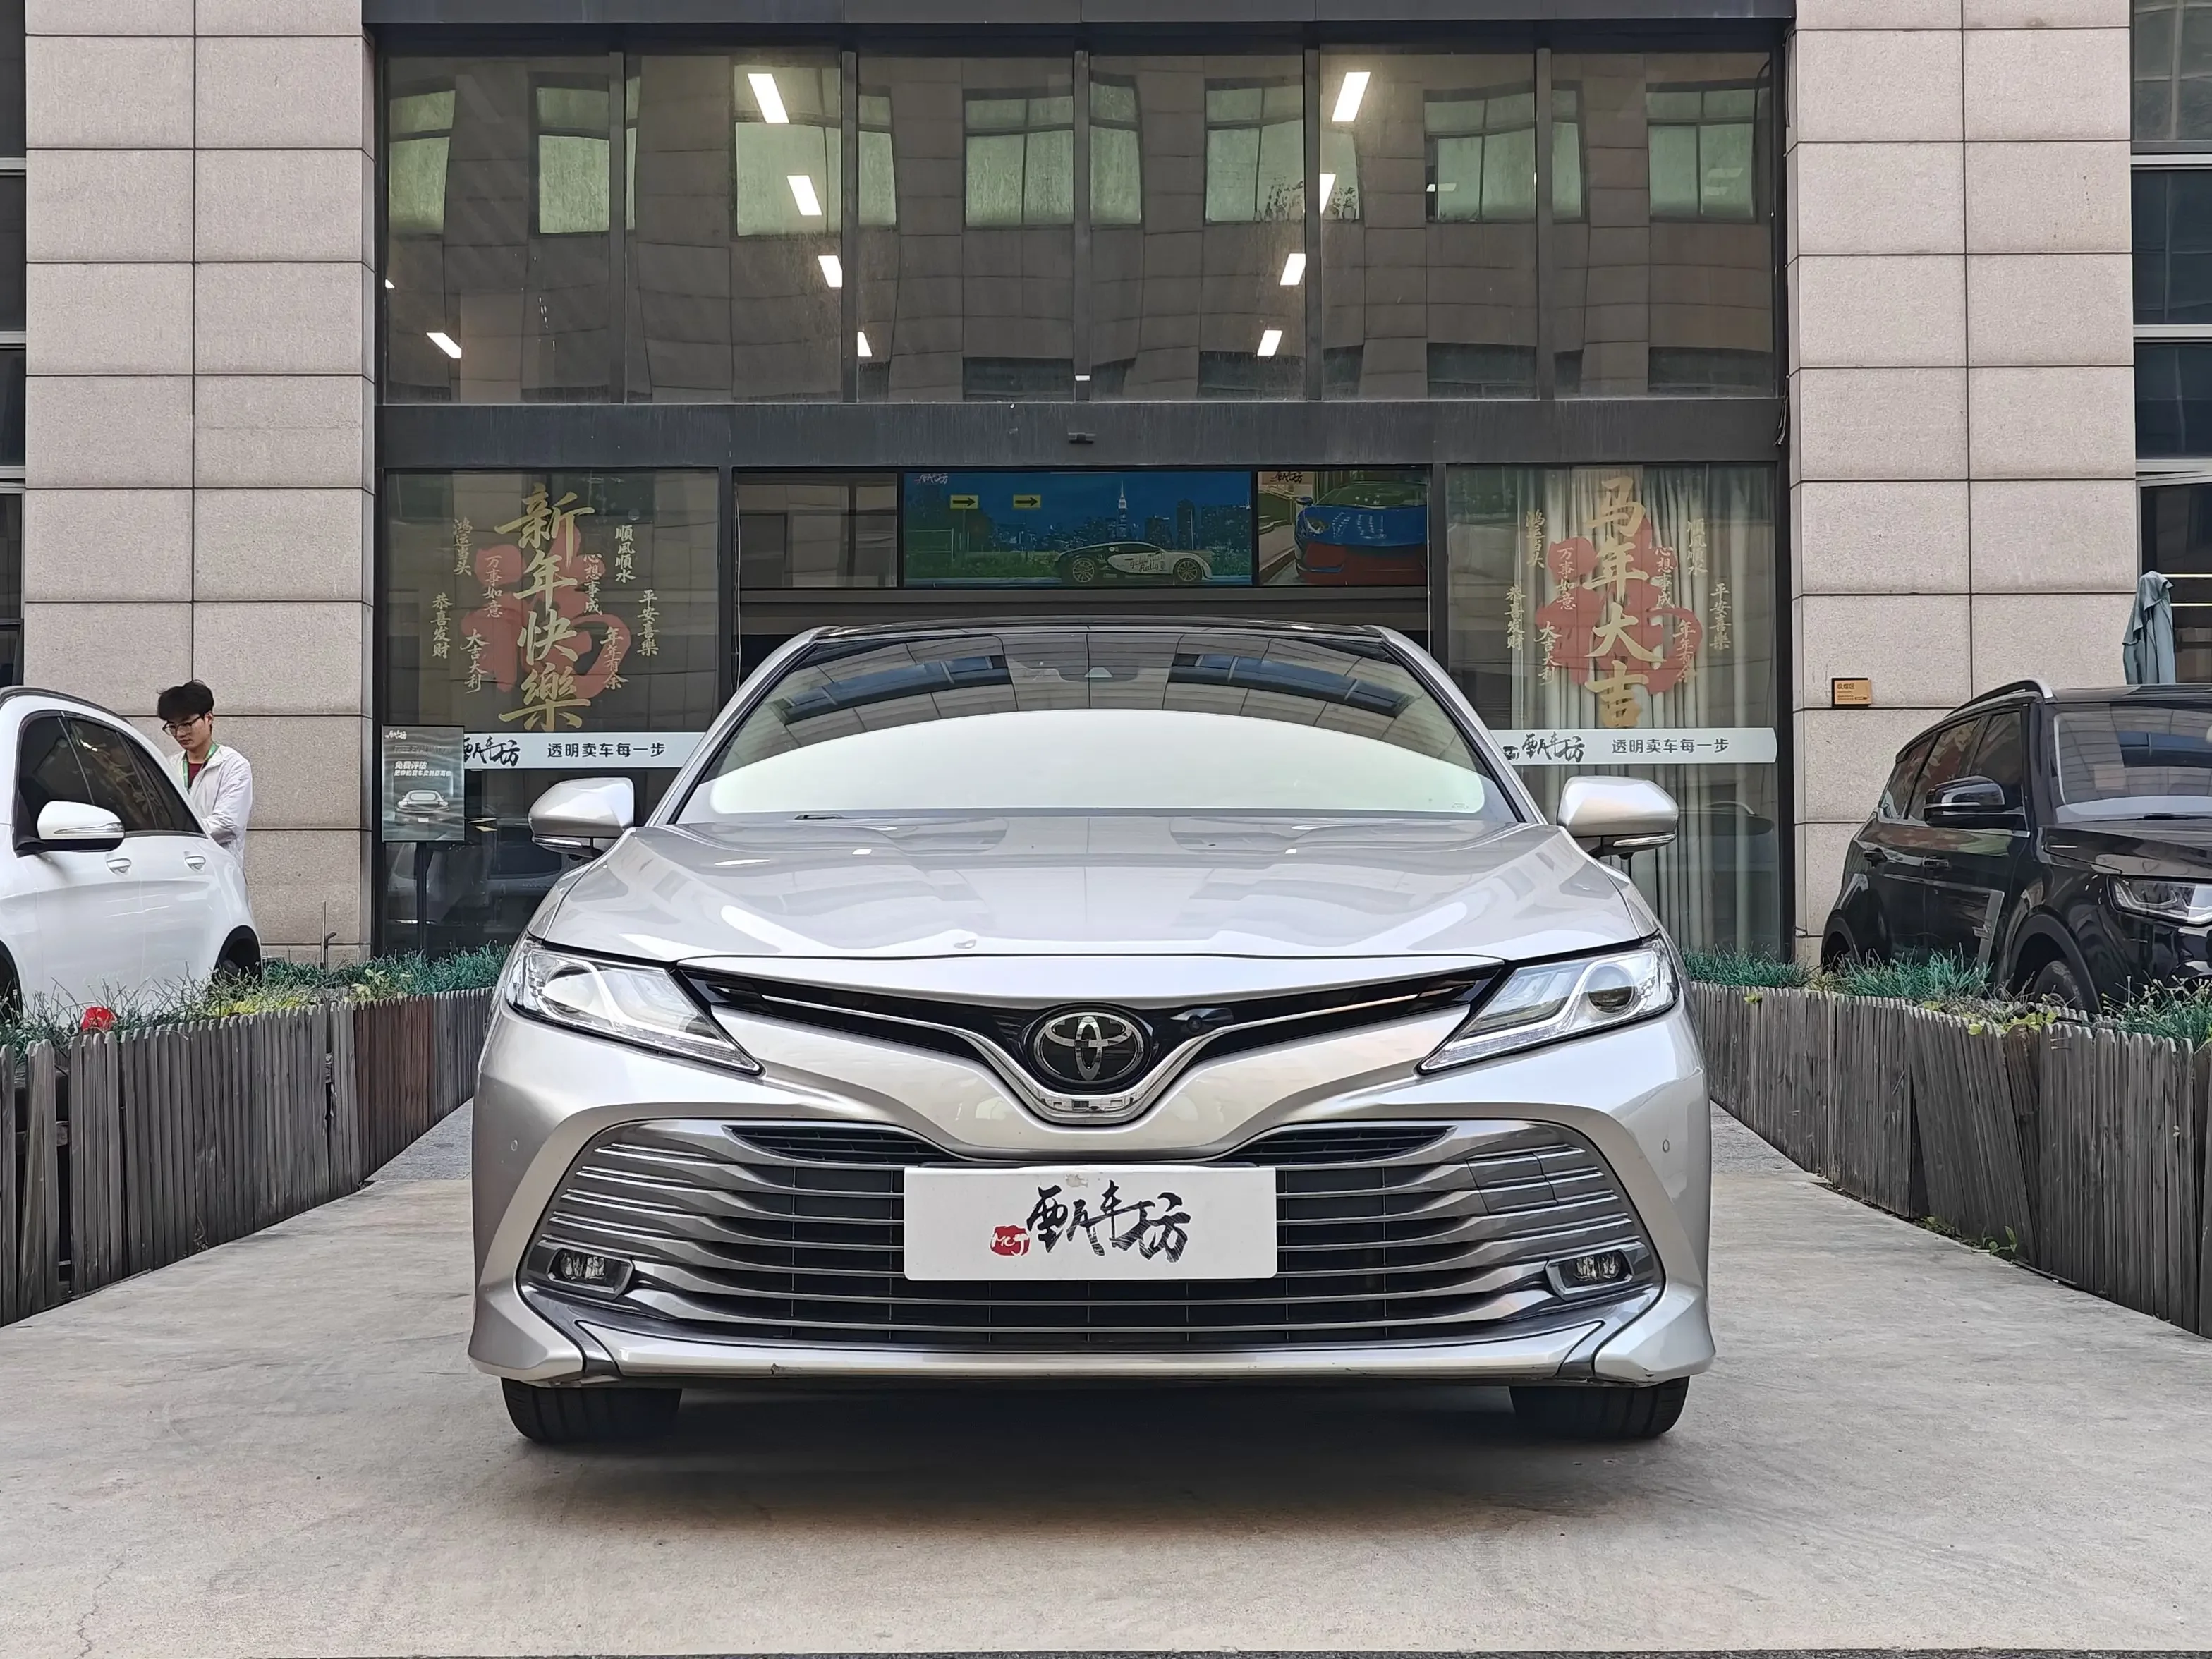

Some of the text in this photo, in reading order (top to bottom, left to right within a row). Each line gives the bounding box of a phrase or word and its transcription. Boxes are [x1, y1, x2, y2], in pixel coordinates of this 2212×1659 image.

[482, 554, 503, 618] 万事如意
[494, 482, 595, 732] 新年快樂
[583, 552, 603, 616] 心想事成
[1555, 547, 1576, 611] 万事如意
[1583, 476, 1667, 728] 马年大吉
[1655, 547, 1676, 610] 心想事成
[430, 592, 454, 659] 恭喜发财
[1505, 583, 1526, 650] 恭喜发财
[460, 628, 489, 694] 大吉大利
[600, 626, 630, 690] 年年有余
[1534, 621, 1562, 686] 大吉大利
[1672, 619, 1698, 683] 年年有余
[547, 742, 666, 758] 透明卖车每一步
[1612, 739, 1730, 755] 透明卖车每一步
